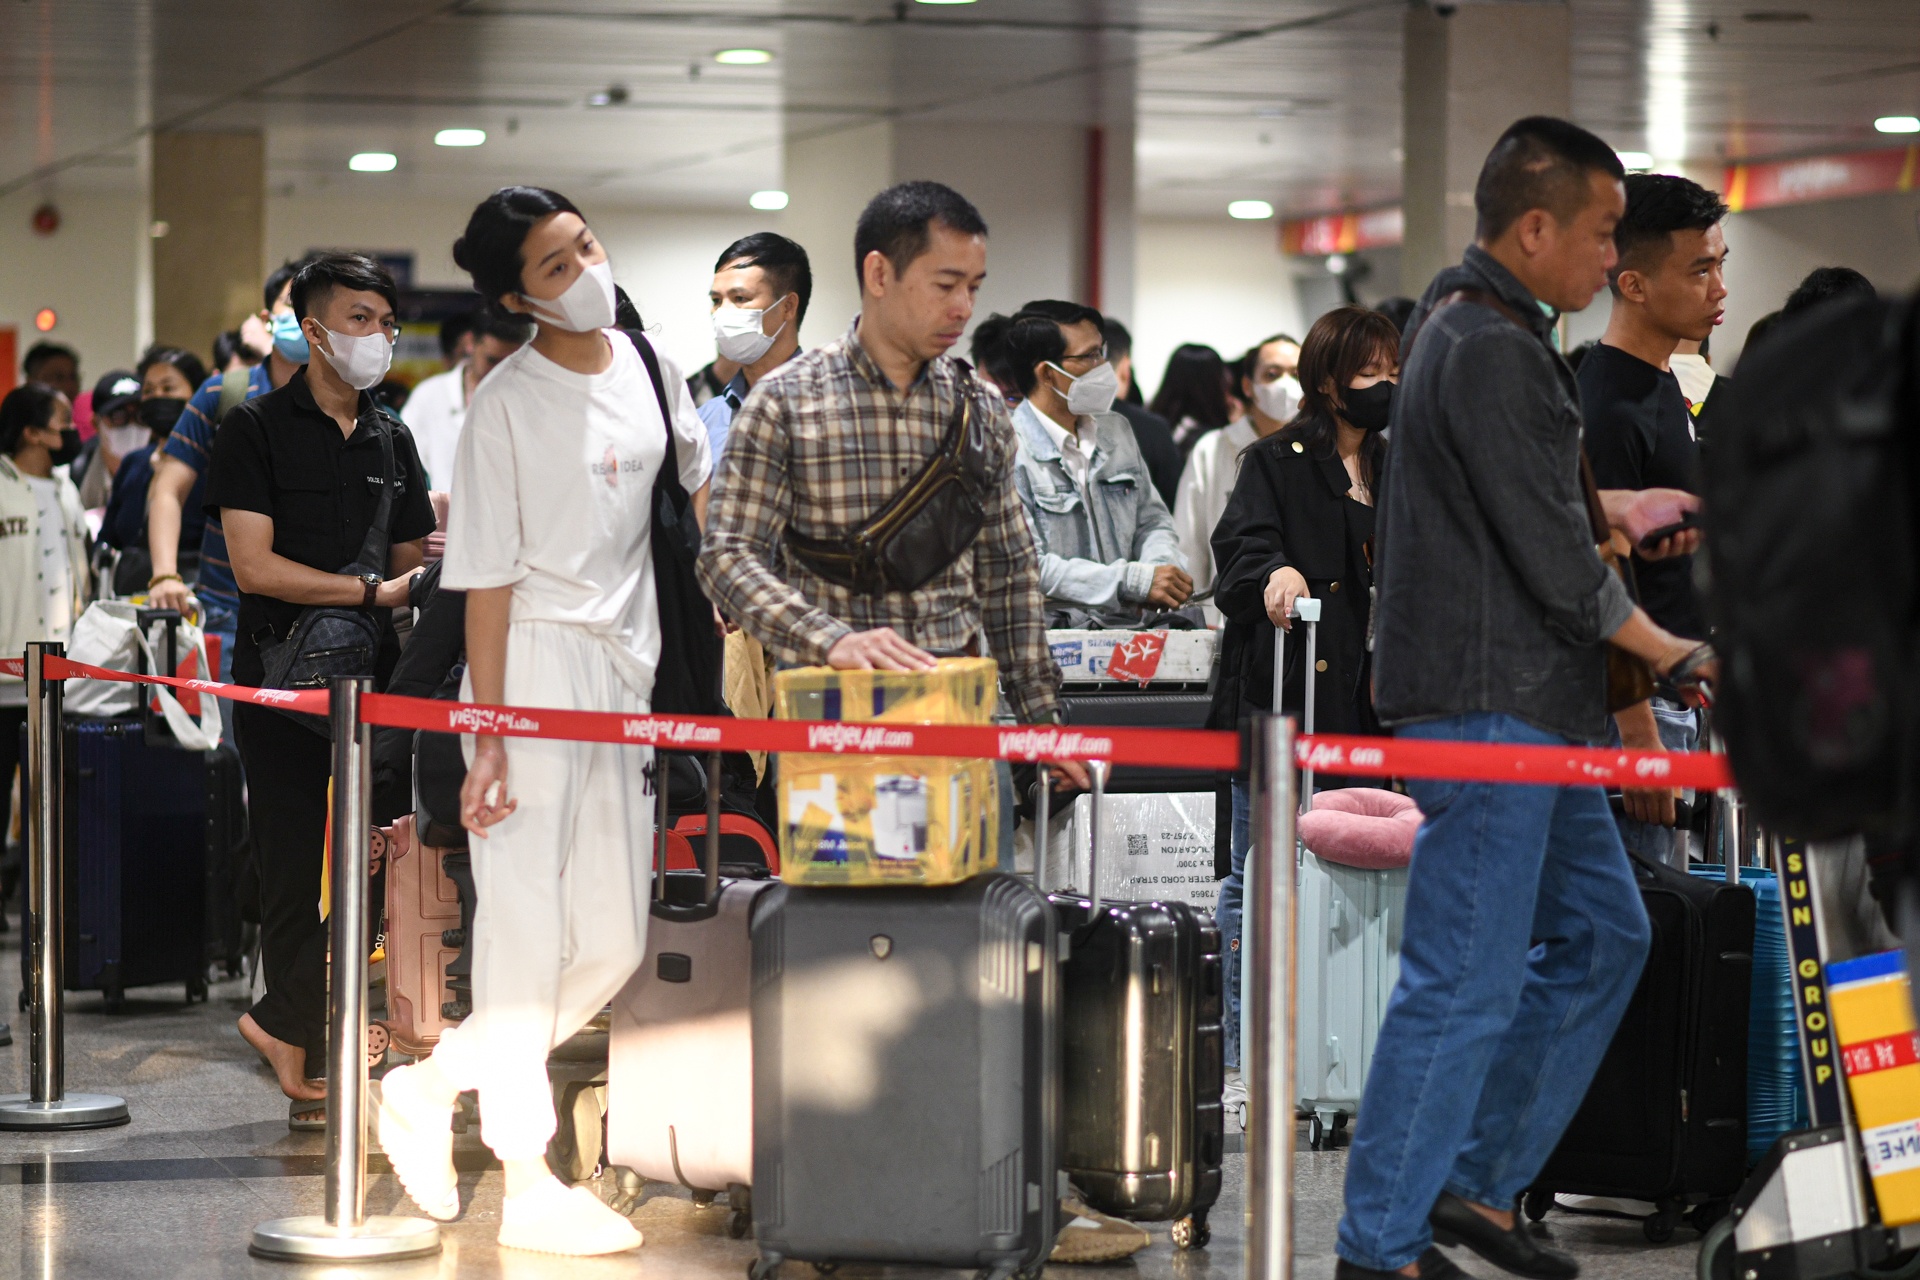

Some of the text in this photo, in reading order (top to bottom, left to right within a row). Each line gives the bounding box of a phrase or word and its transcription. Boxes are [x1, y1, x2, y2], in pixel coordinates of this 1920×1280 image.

[1130, 876, 1159, 884] STRAP
[1161, 876, 1186, 884] CORD
[1787, 853, 1811, 926] SUN
[1798, 958, 1832, 1084] GROUP
